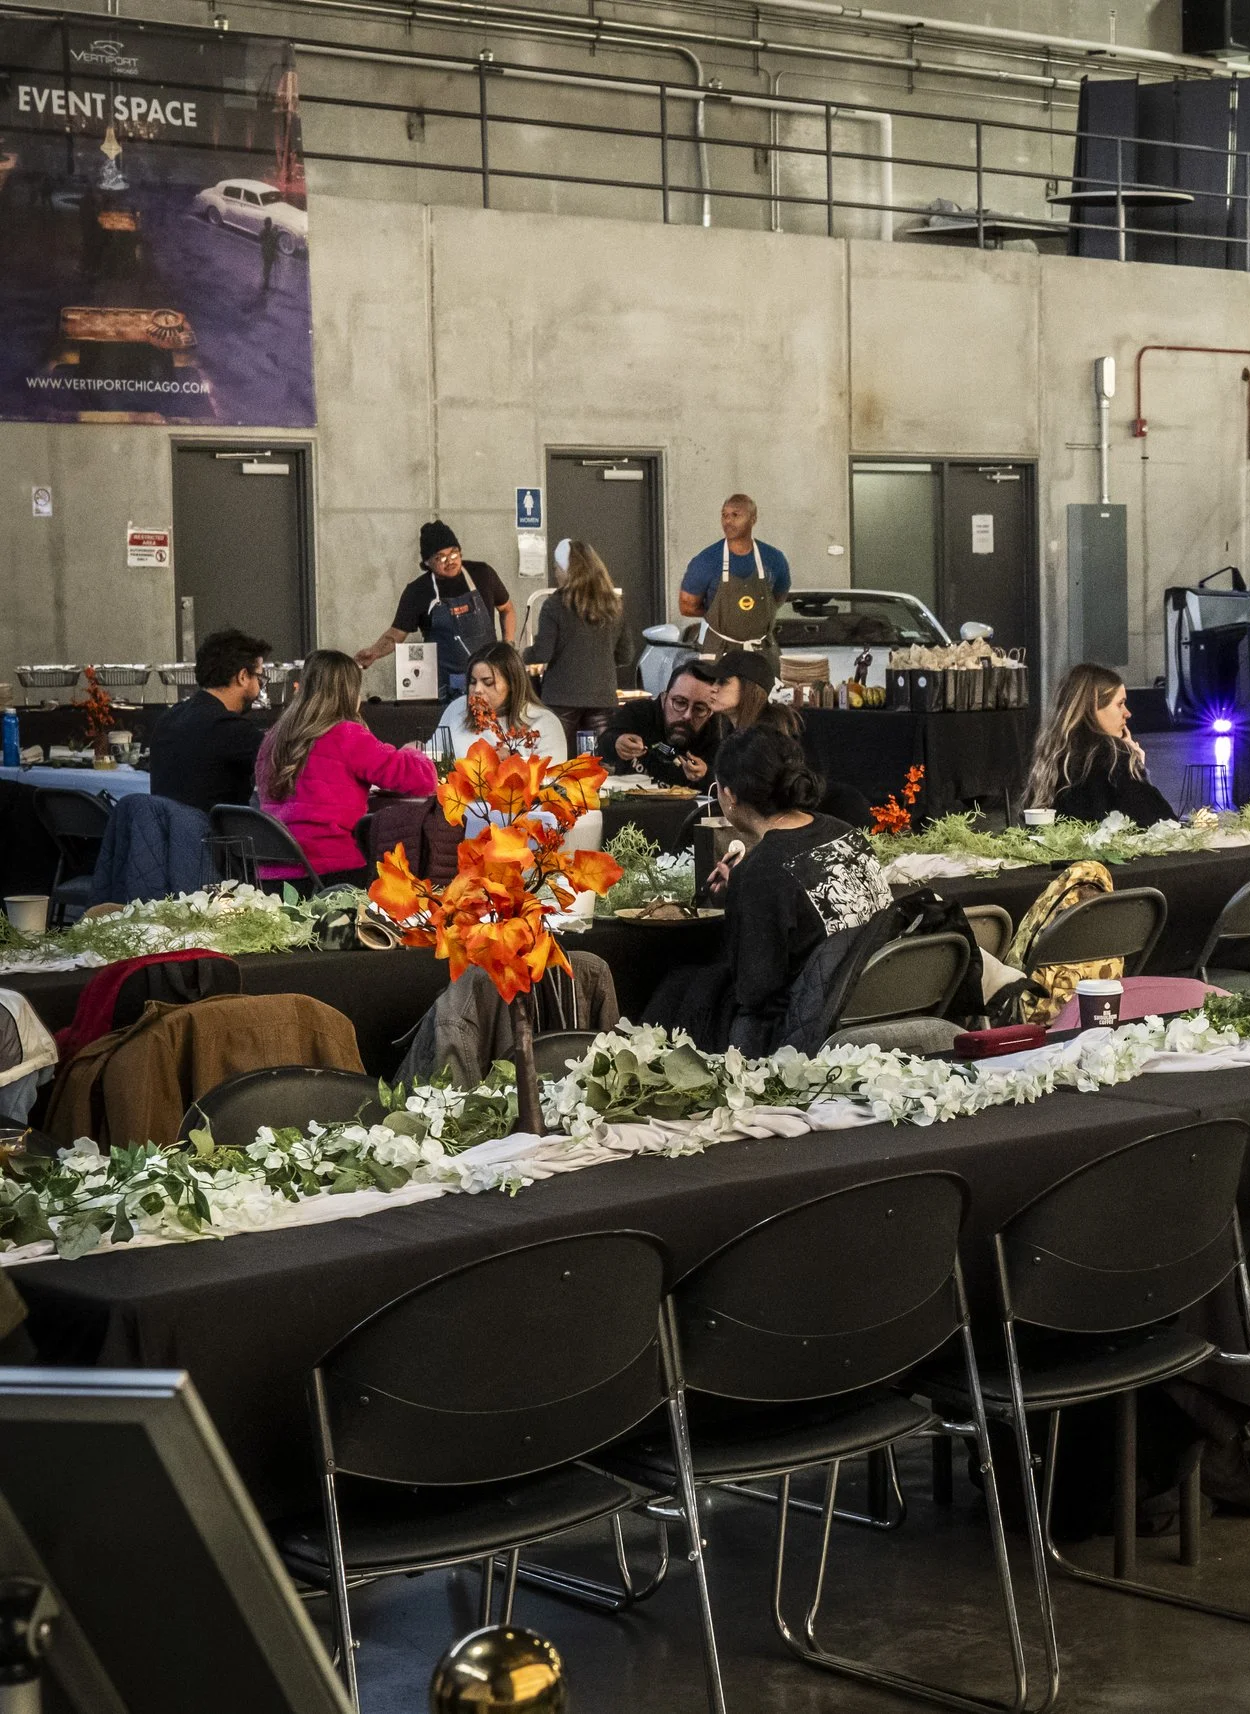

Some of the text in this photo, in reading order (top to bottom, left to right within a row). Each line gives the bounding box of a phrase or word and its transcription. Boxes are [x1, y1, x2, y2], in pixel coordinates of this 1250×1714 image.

[70, 48, 139, 67] VERTIPORT
[18, 85, 198, 127] EVENT SPACE
[26, 377, 211, 394] WWW.VERTIPORTCHICAGO.COM
